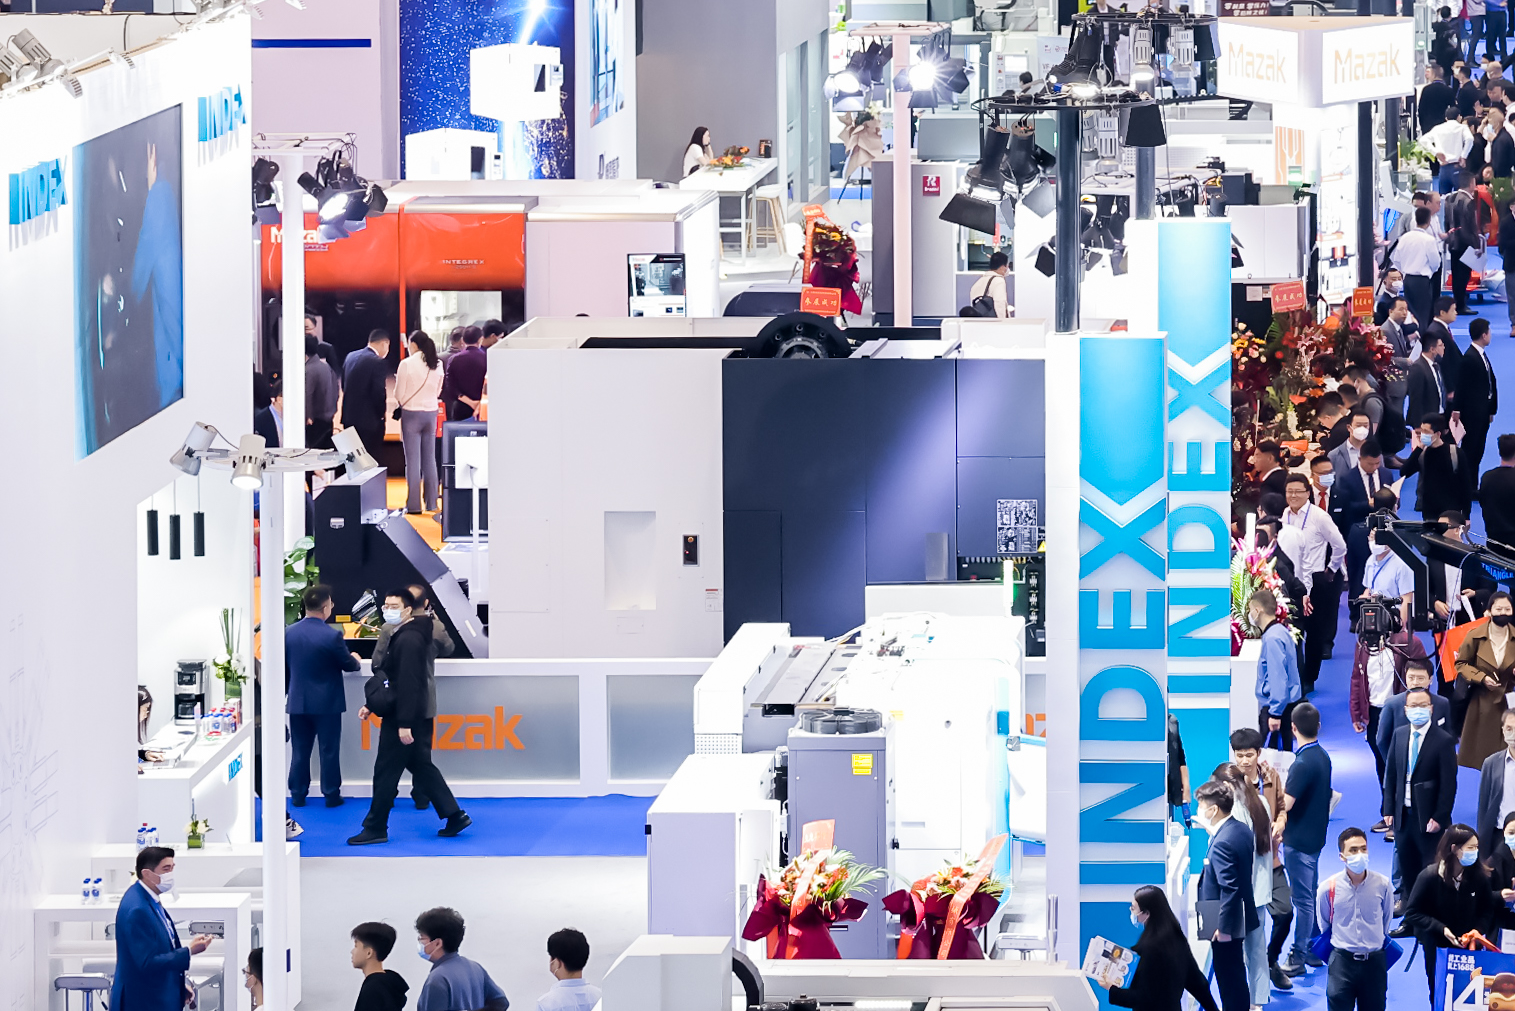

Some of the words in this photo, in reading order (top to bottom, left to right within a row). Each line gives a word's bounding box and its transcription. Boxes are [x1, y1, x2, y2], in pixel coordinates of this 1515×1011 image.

[1228, 42, 1286, 84] Mazak
[1334, 43, 1400, 84] Mazak
[198, 83, 247, 142] INDEX
[8, 155, 68, 225] INDEX
[1168, 352, 1231, 694] INDEX
[1079, 498, 1166, 885] INDEX
[361, 706, 526, 751] Mzak
